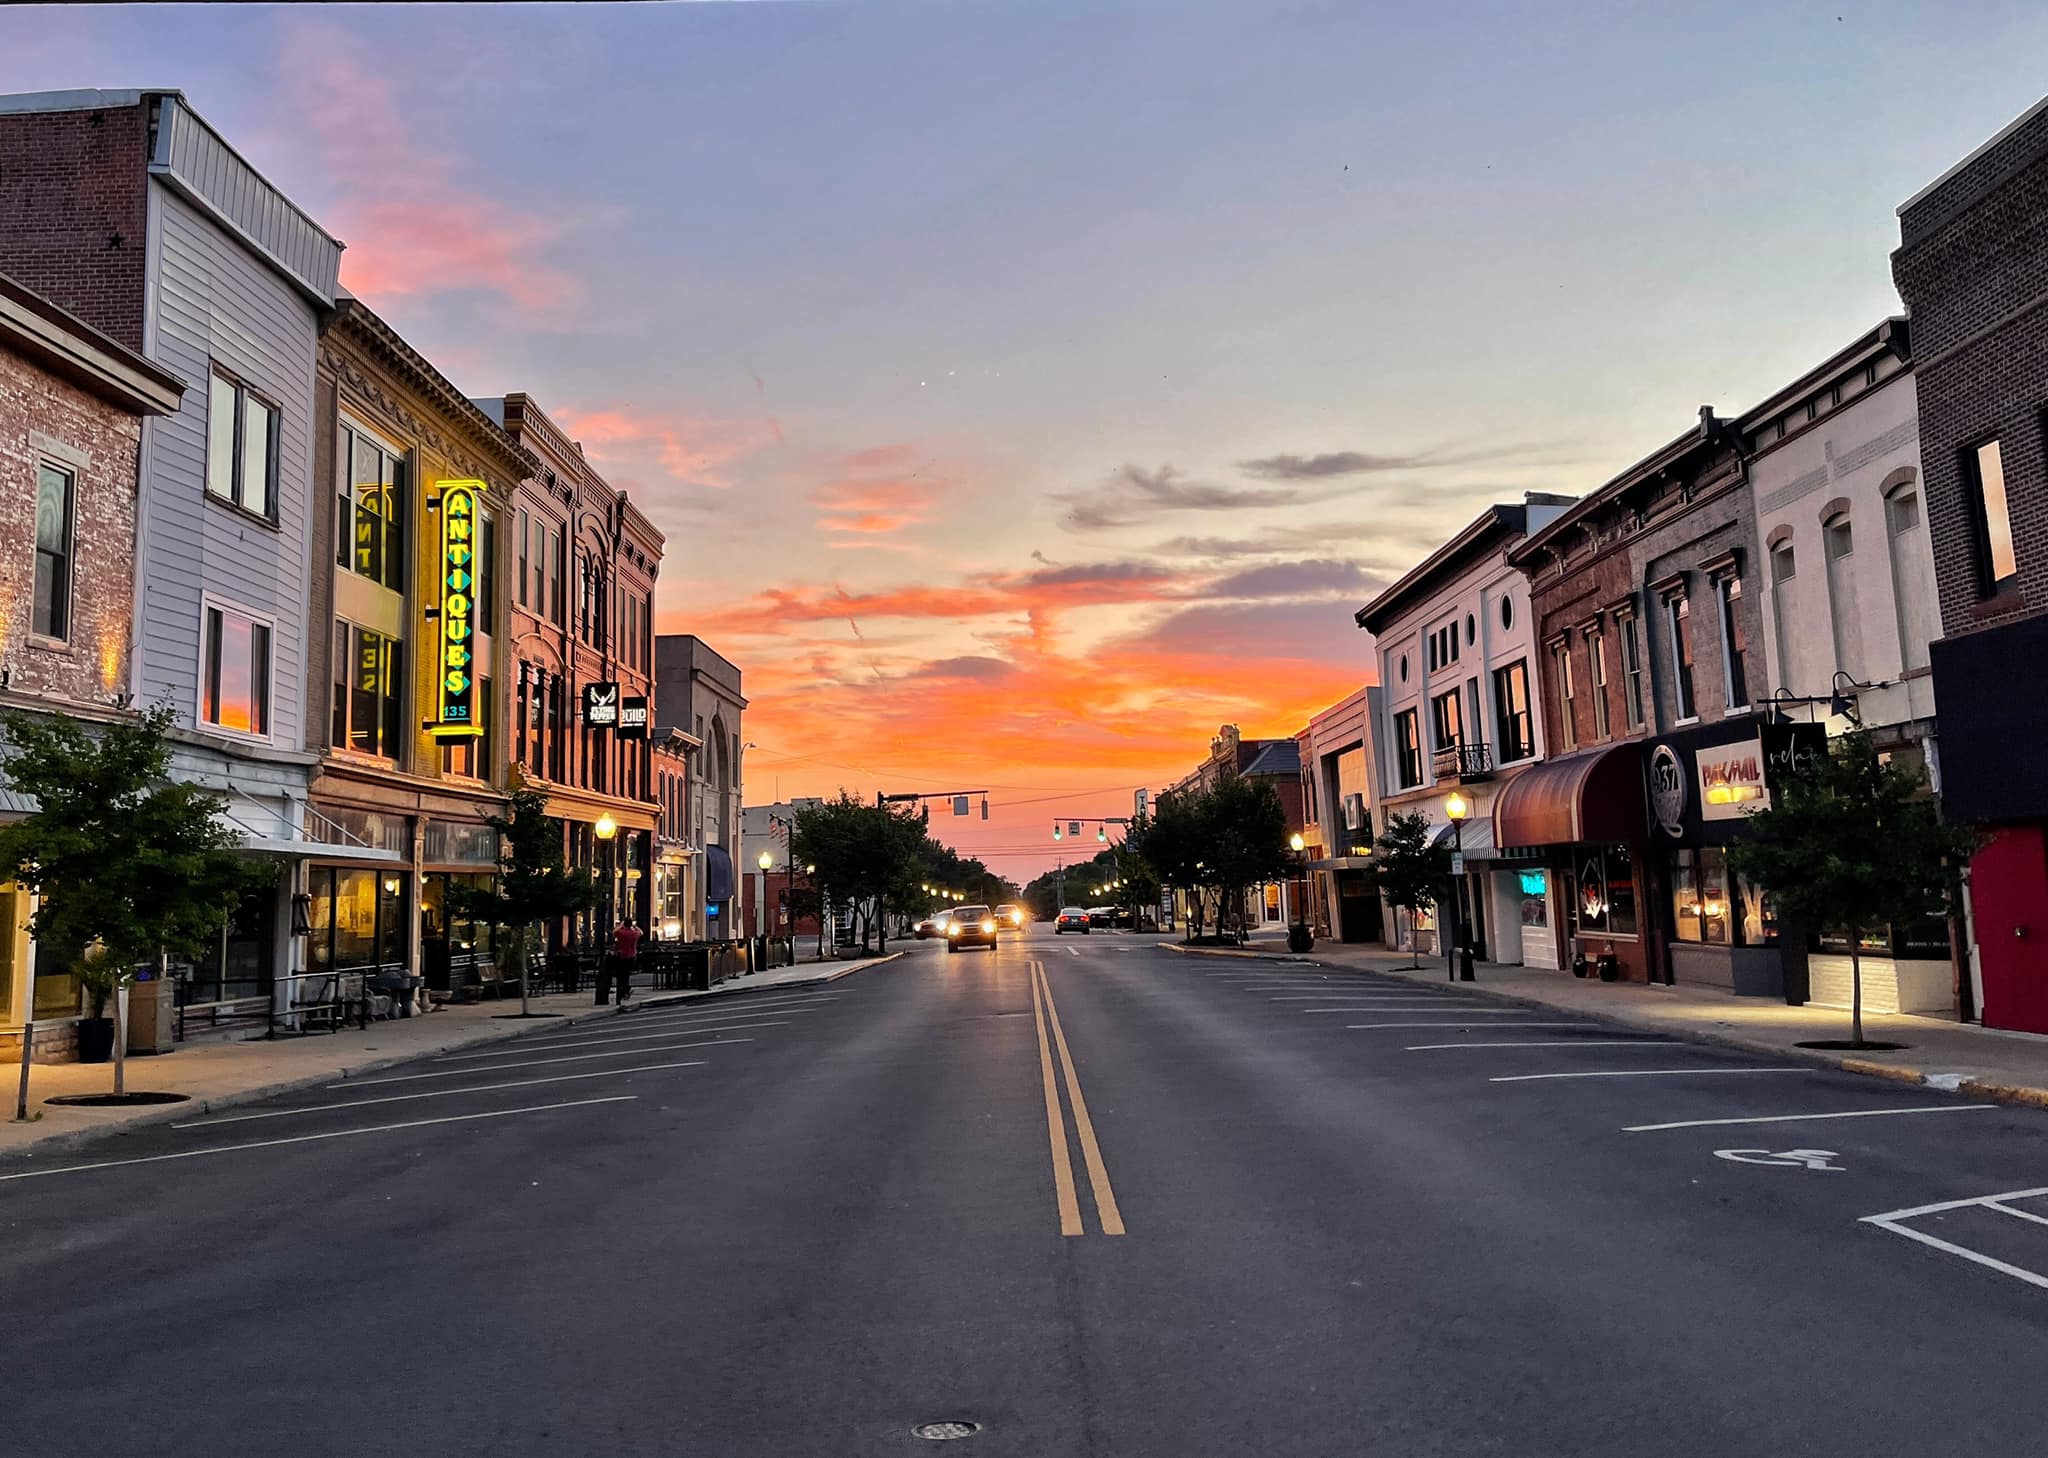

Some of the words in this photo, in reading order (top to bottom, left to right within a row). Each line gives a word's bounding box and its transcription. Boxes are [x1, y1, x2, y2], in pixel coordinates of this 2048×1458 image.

[447, 493, 471, 693] ANTIQUES
[444, 705, 468, 717] 135
[1653, 763, 1680, 794] 937
